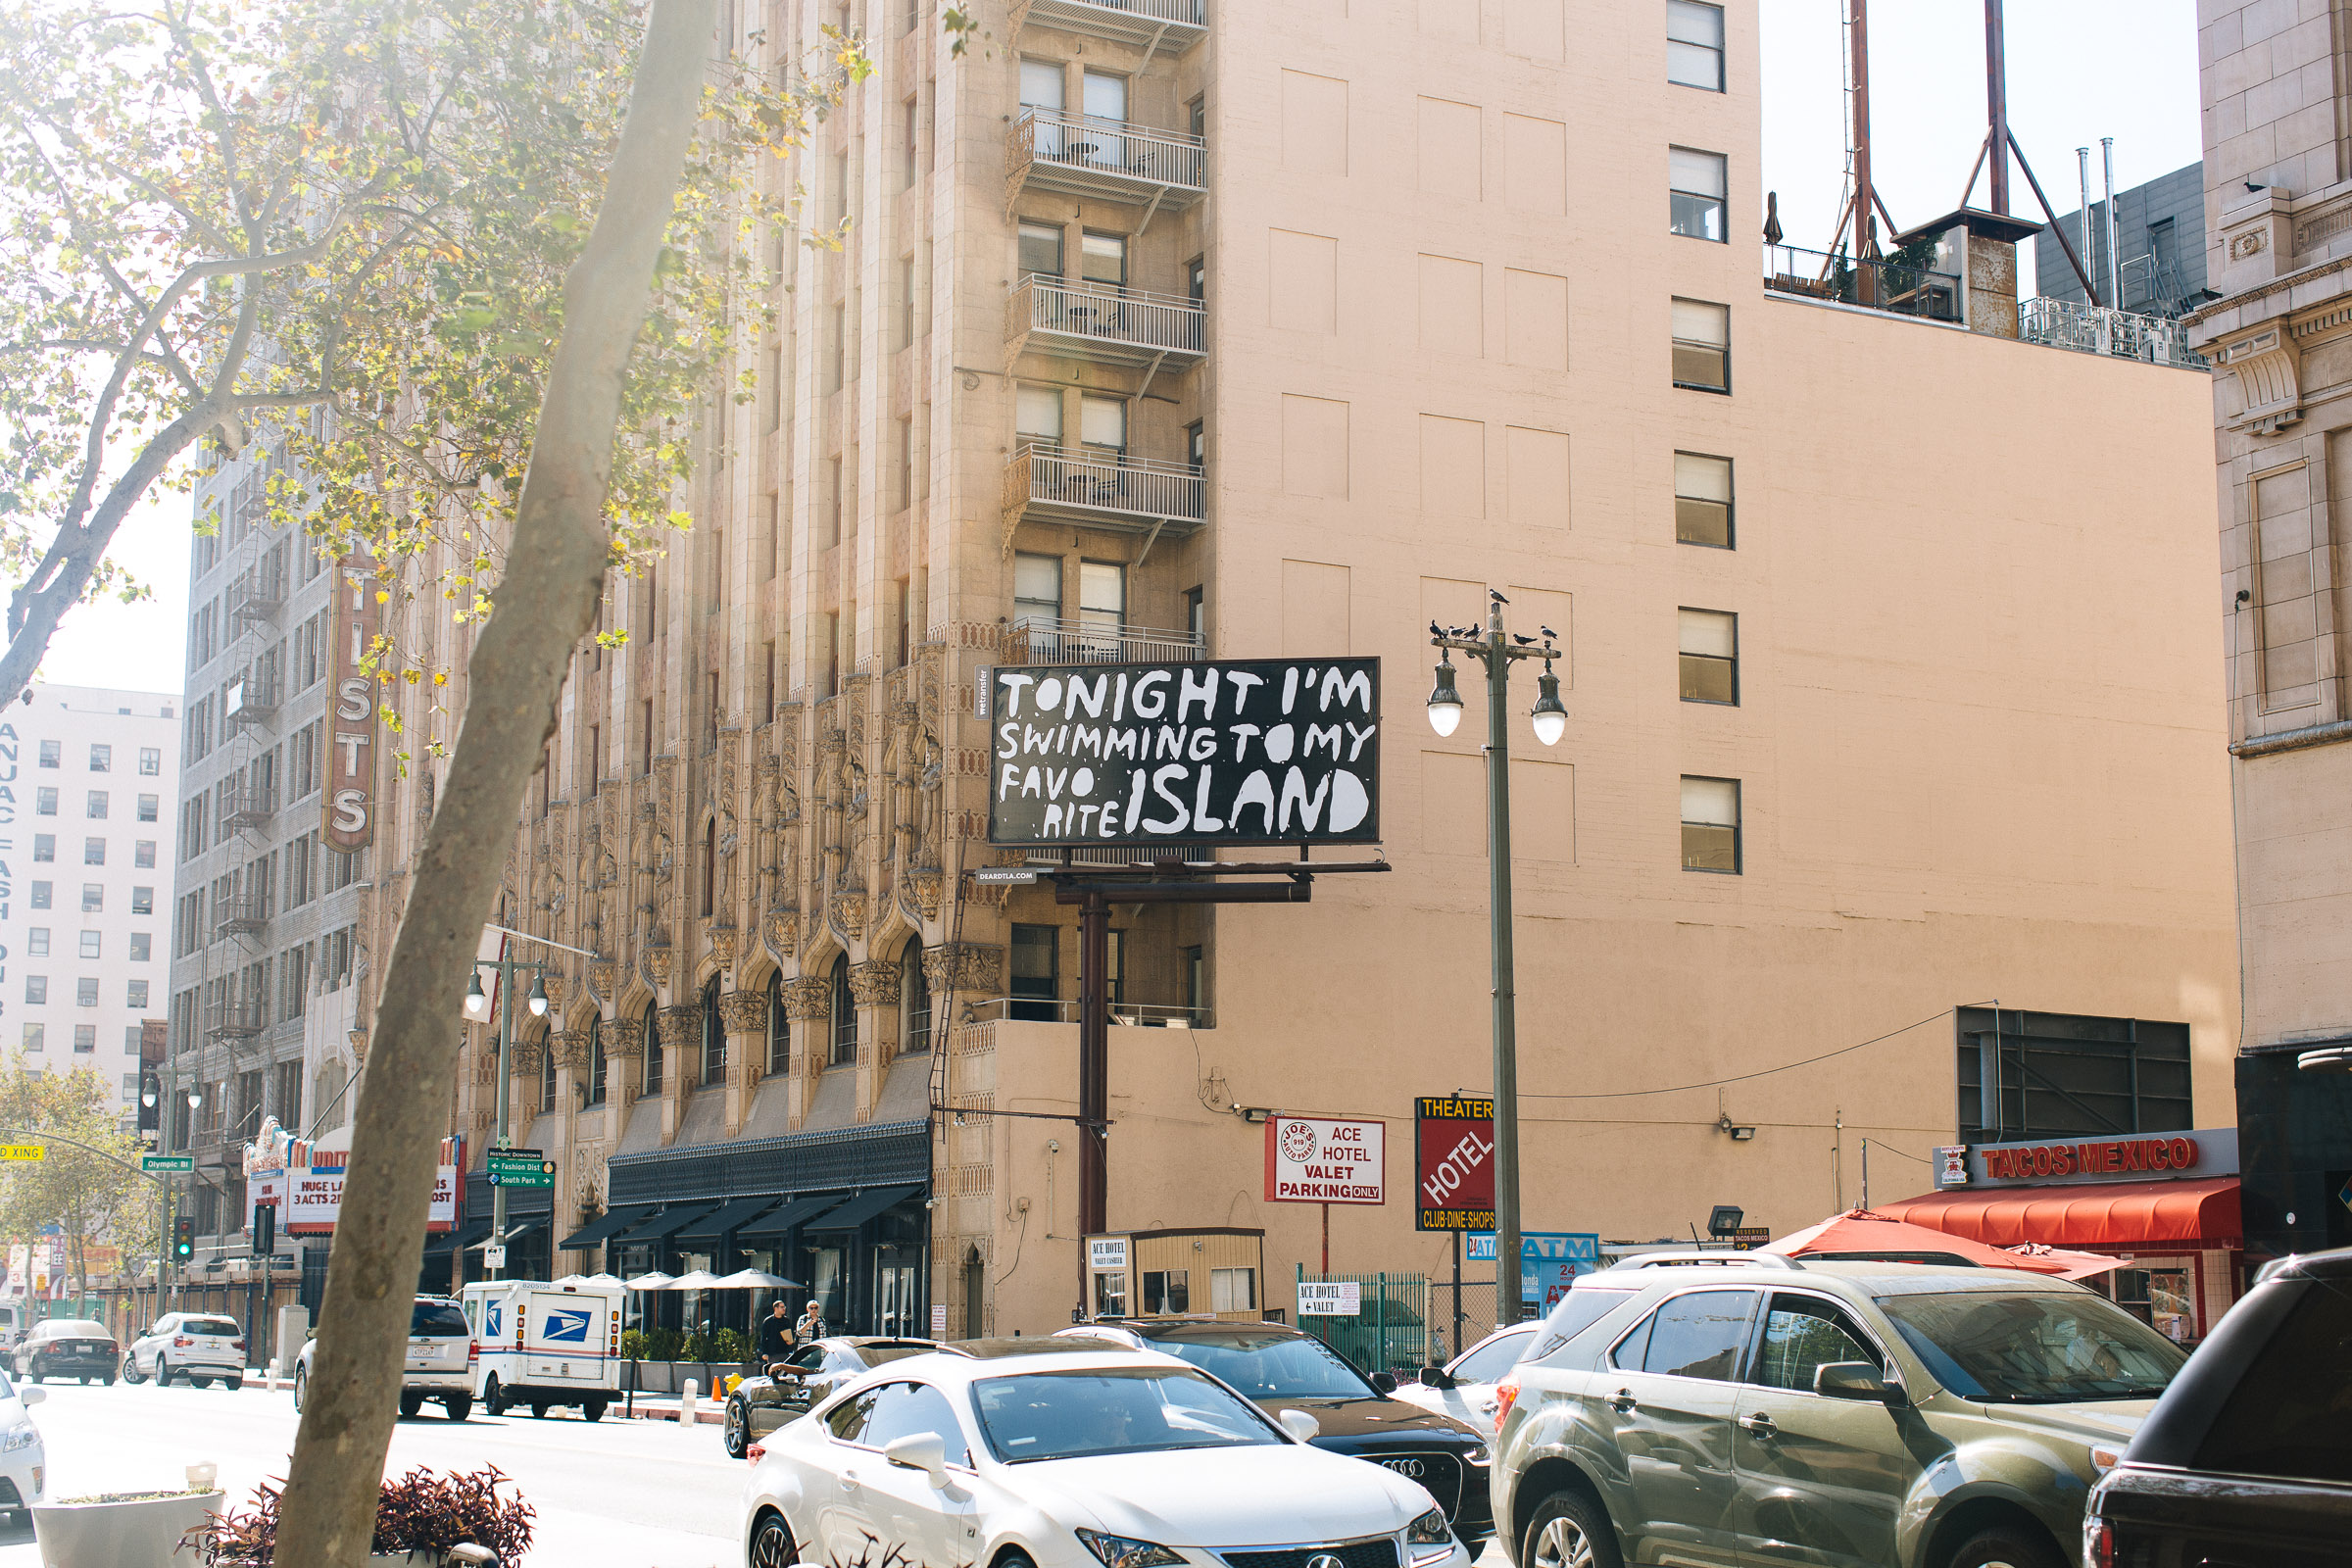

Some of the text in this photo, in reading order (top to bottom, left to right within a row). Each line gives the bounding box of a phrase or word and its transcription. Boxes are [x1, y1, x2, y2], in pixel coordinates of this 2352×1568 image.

[999, 665, 1371, 723] TONIGHT I'M
[997, 720, 1375, 763] SWIMMING TO MY
[999, 763, 1095, 803] FAVO
[1043, 763, 1369, 839] RITE ISLAND
[1423, 1100, 1494, 1118] THEATER
[1284, 1124, 1314, 1142] JOE'S
[1332, 1127, 1361, 1141] ACE
[13, 1148, 39, 1158] XING
[1284, 1142, 1313, 1159] AUTO PARKS
[1323, 1147, 1371, 1161] HOTEL
[1982, 1137, 2195, 1179] TACOS MEXICO
[148, 1160, 177, 1169] Olympic
[314, 1151, 350, 1167] UNIT
[1304, 1165, 1353, 1179] VALET
[1423, 1130, 1494, 1206] HOTEL
[302, 1181, 328, 1192] HUGE
[1280, 1182, 1379, 1198] PARKING ONLY
[294, 1195, 301, 1204] 3
[302, 1194, 328, 1204] ACTS
[431, 1193, 452, 1202] OST
[1093, 1242, 1125, 1254] ACE HOTEL
[1476, 1240, 1495, 1256] AT
[1522, 1239, 1593, 1257] ATM
[1560, 1264, 1576, 1276] 24
[1299, 1286, 1313, 1298] ACE
[1316, 1286, 1340, 1298] HOTEL
[1545, 1285, 1572, 1304] AT
[1313, 1301, 1334, 1311] VALET
